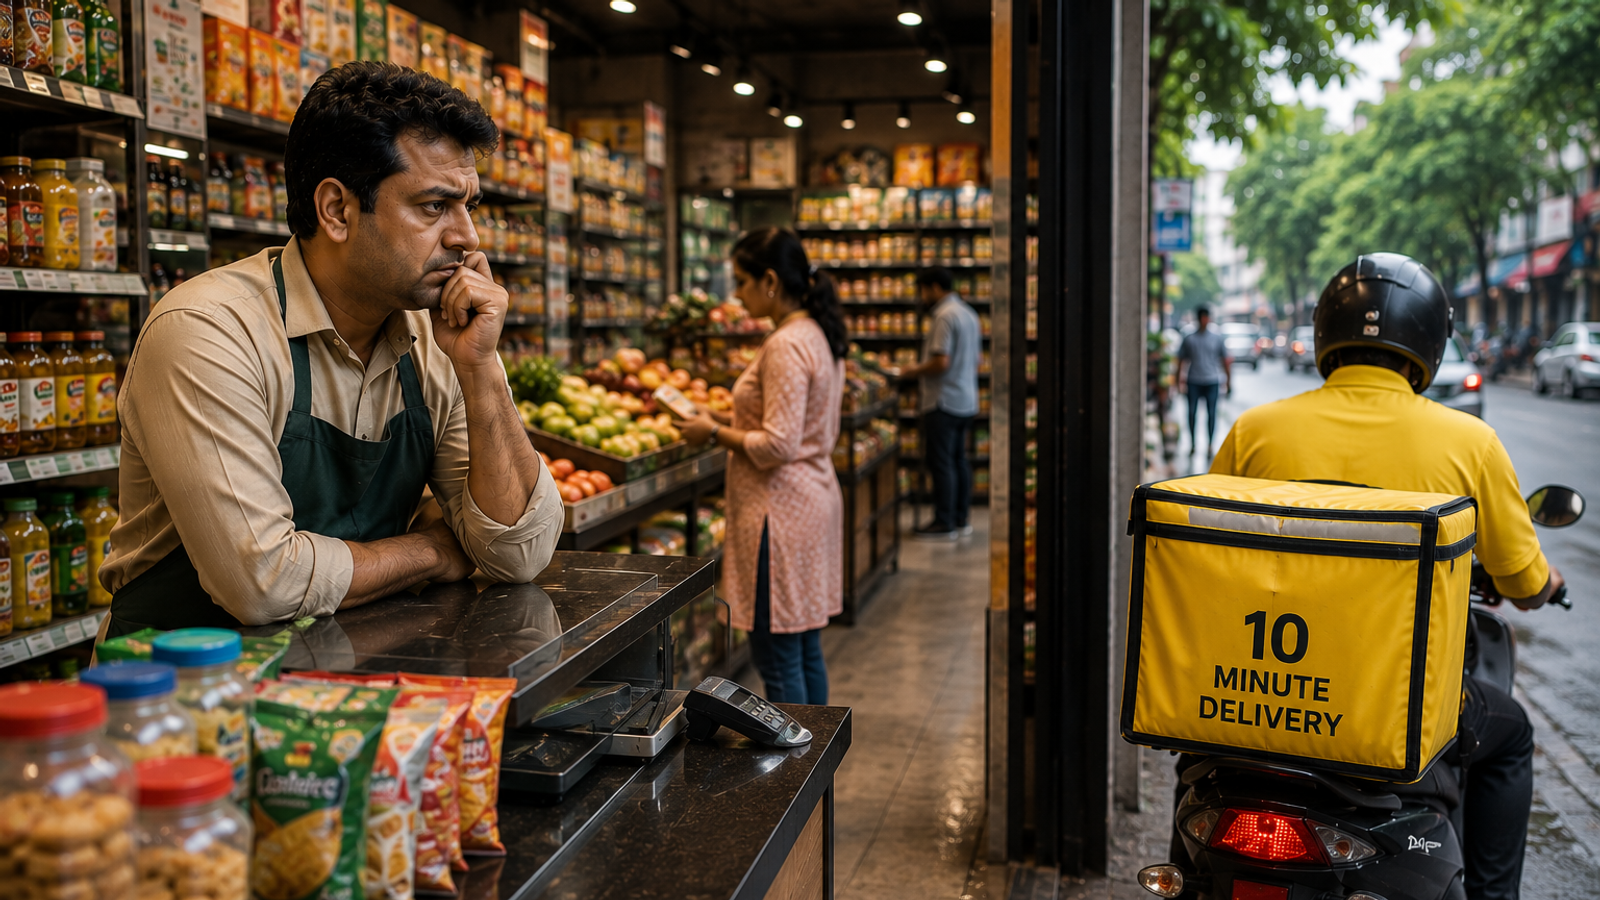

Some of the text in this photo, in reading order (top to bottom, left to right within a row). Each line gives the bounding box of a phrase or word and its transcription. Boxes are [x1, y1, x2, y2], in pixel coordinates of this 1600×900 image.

[1244, 610, 1309, 664] 10
[1213, 664, 1331, 703] MINUTE
[1198, 694, 1344, 737] DELIVERY
